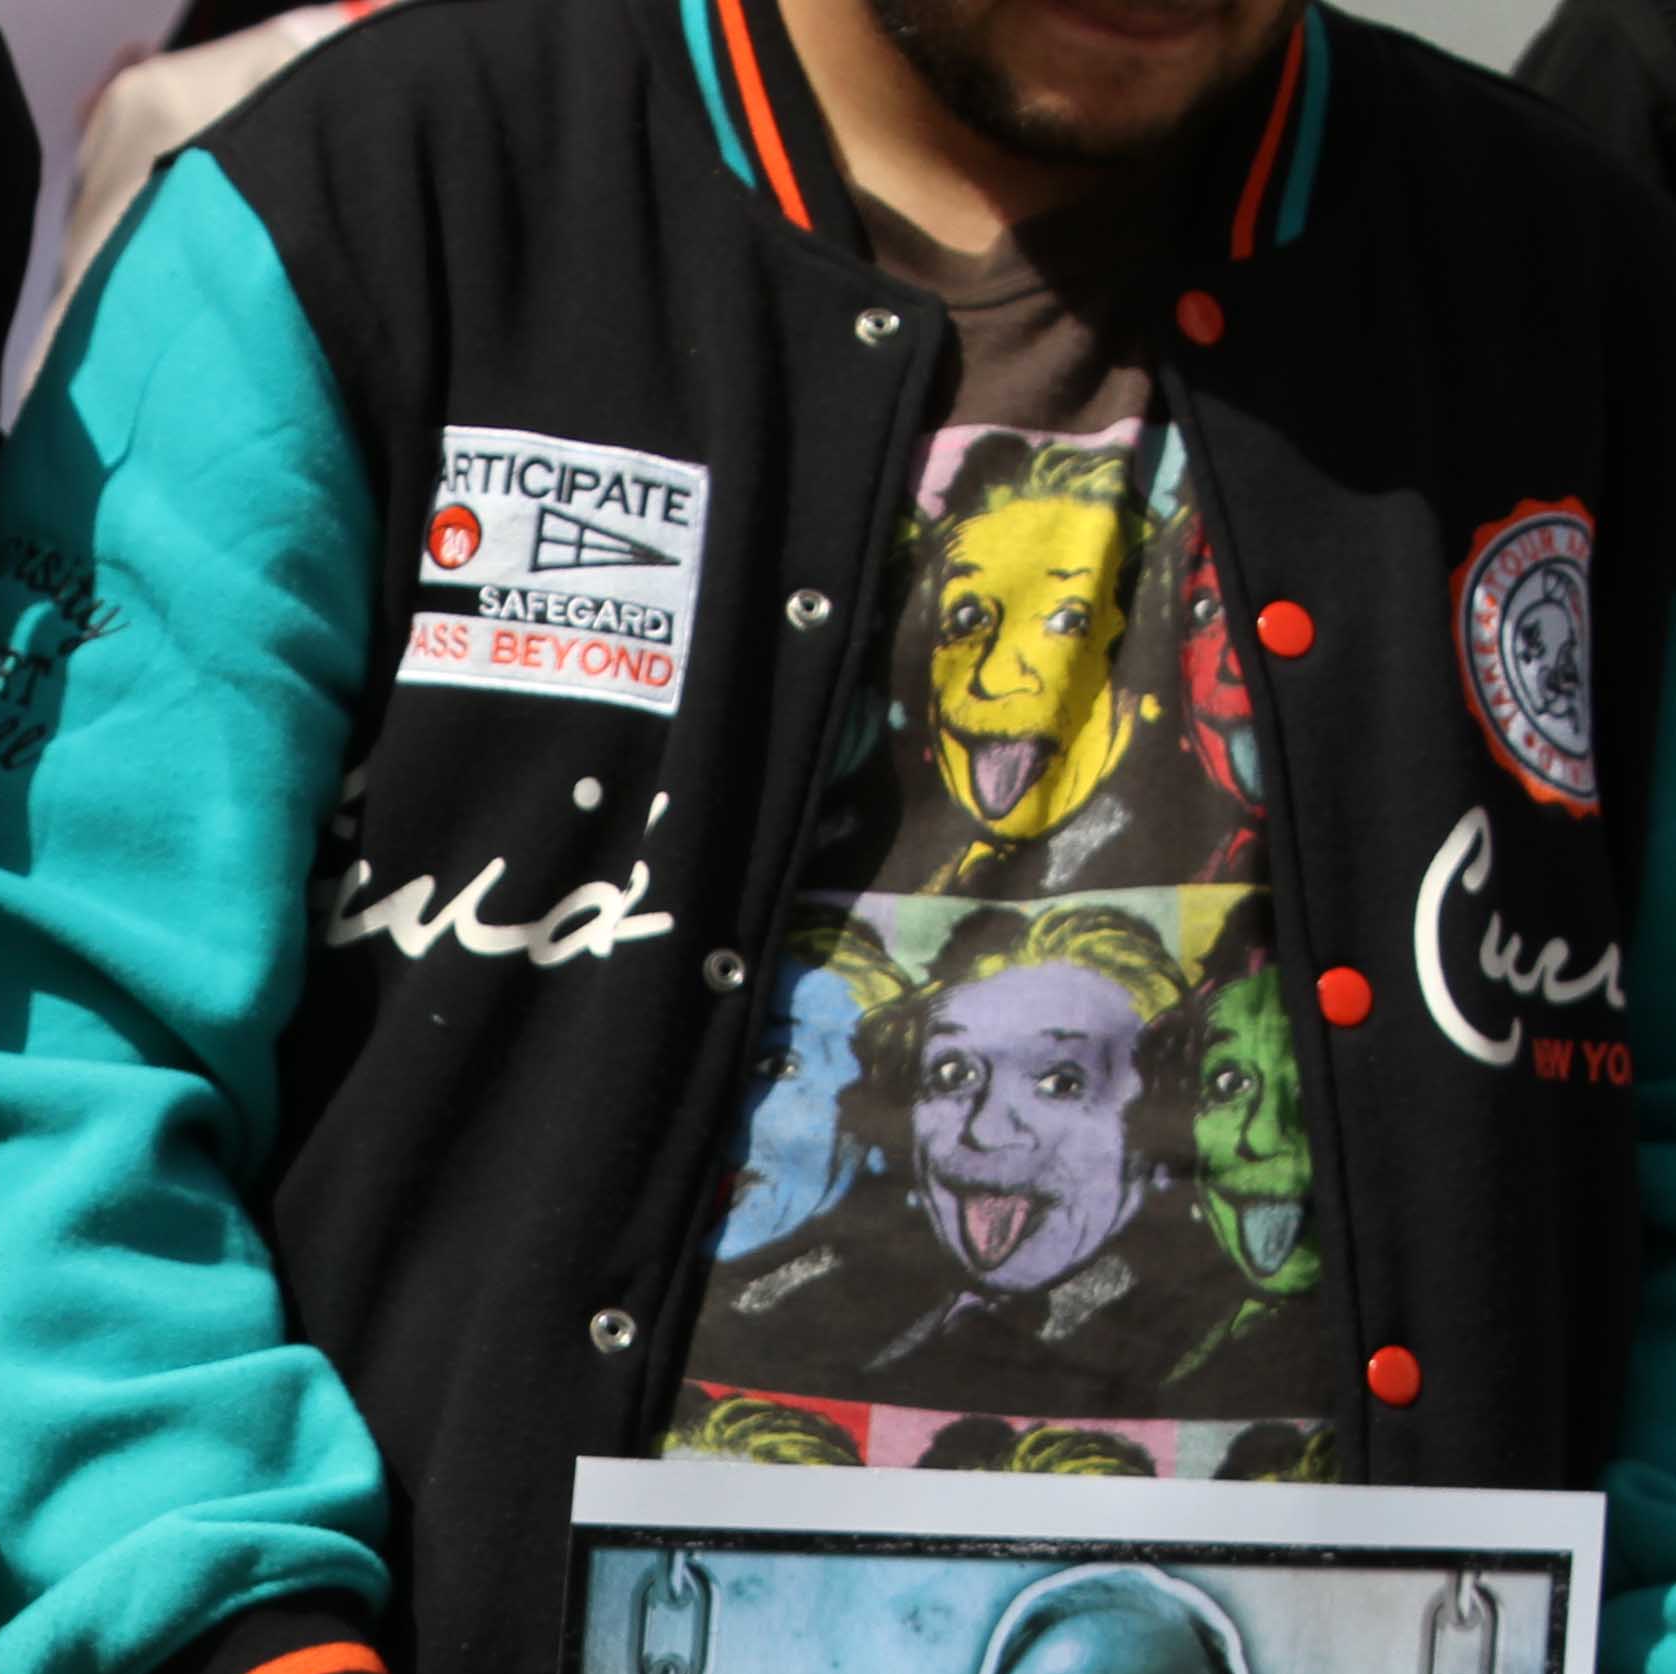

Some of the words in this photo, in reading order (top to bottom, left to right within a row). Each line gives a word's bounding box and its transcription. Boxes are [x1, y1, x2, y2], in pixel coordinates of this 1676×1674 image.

[443, 450, 691, 526] RTICIPATE
[479, 585, 669, 638] SAFEGARD
[491, 631, 673, 687] BEYOND
[1582, 1039, 1634, 1086] YO
